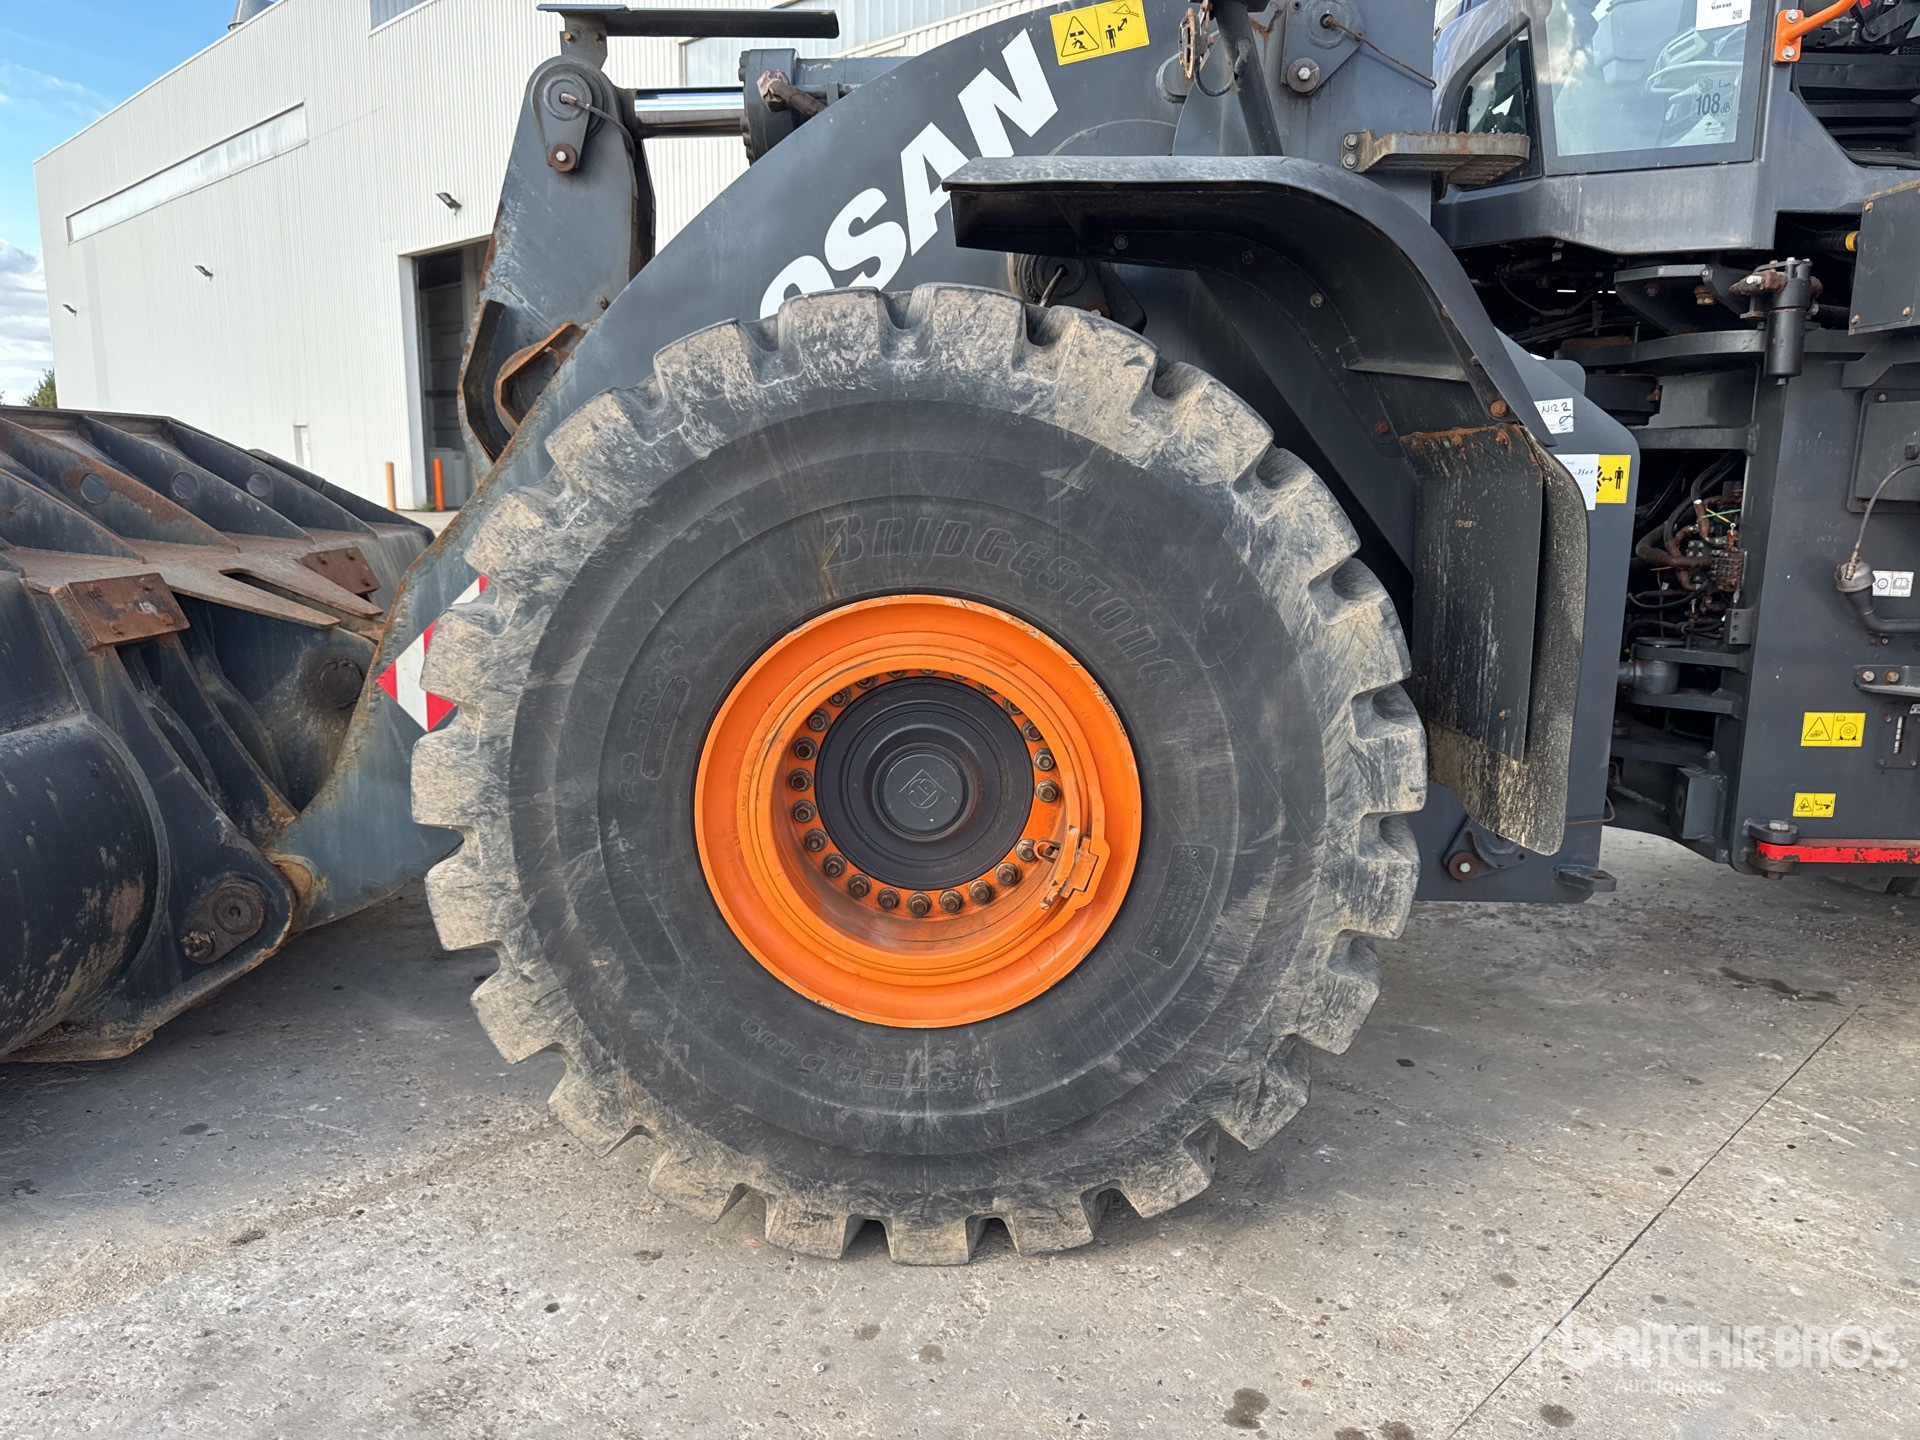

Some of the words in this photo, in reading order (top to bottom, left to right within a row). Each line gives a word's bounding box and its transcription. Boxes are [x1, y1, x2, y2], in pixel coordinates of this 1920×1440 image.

[1696, 92, 1720, 115] 108
[1720, 102, 1731, 114] dB
[822, 514, 1182, 688] BRIDGESTONE
